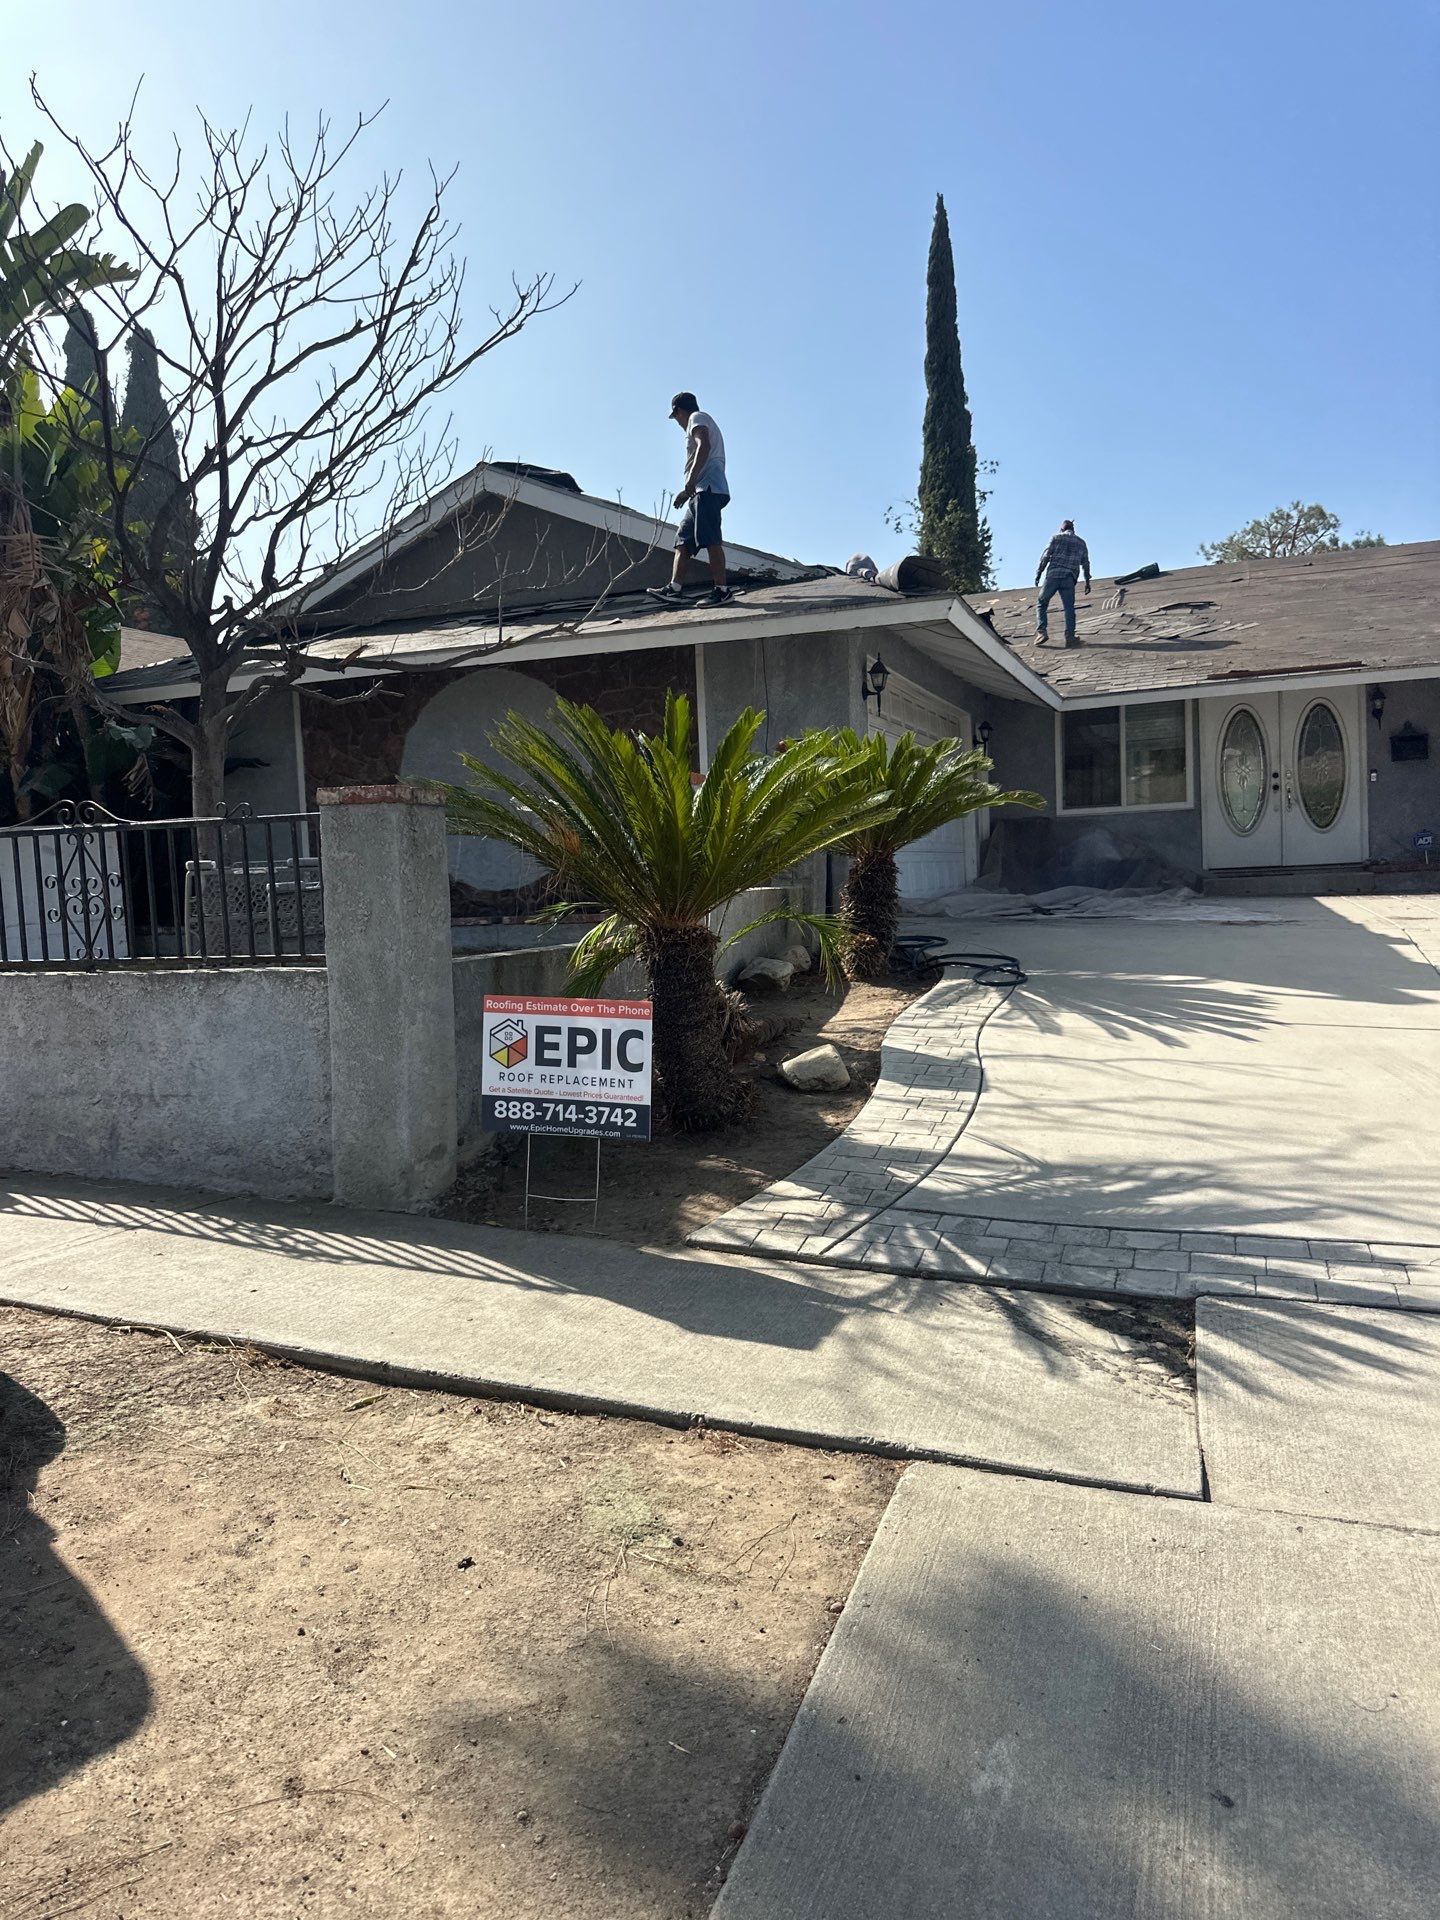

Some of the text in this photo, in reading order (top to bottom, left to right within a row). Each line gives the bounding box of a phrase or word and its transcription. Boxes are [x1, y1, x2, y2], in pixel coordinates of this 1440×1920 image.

[486, 1000, 650, 1016] Roofing Estimate Over The Phone
[535, 1026, 644, 1073] EPIC
[499, 1072, 634, 1088] ROOF REPLACEMENT
[534, 1088, 554, 1096] Quote
[604, 1093, 643, 1101] Guaranteed!
[494, 1101, 636, 1127] 888-714-3742
[510, 1124, 621, 1138] www.EpicHomeUpgrades.com
